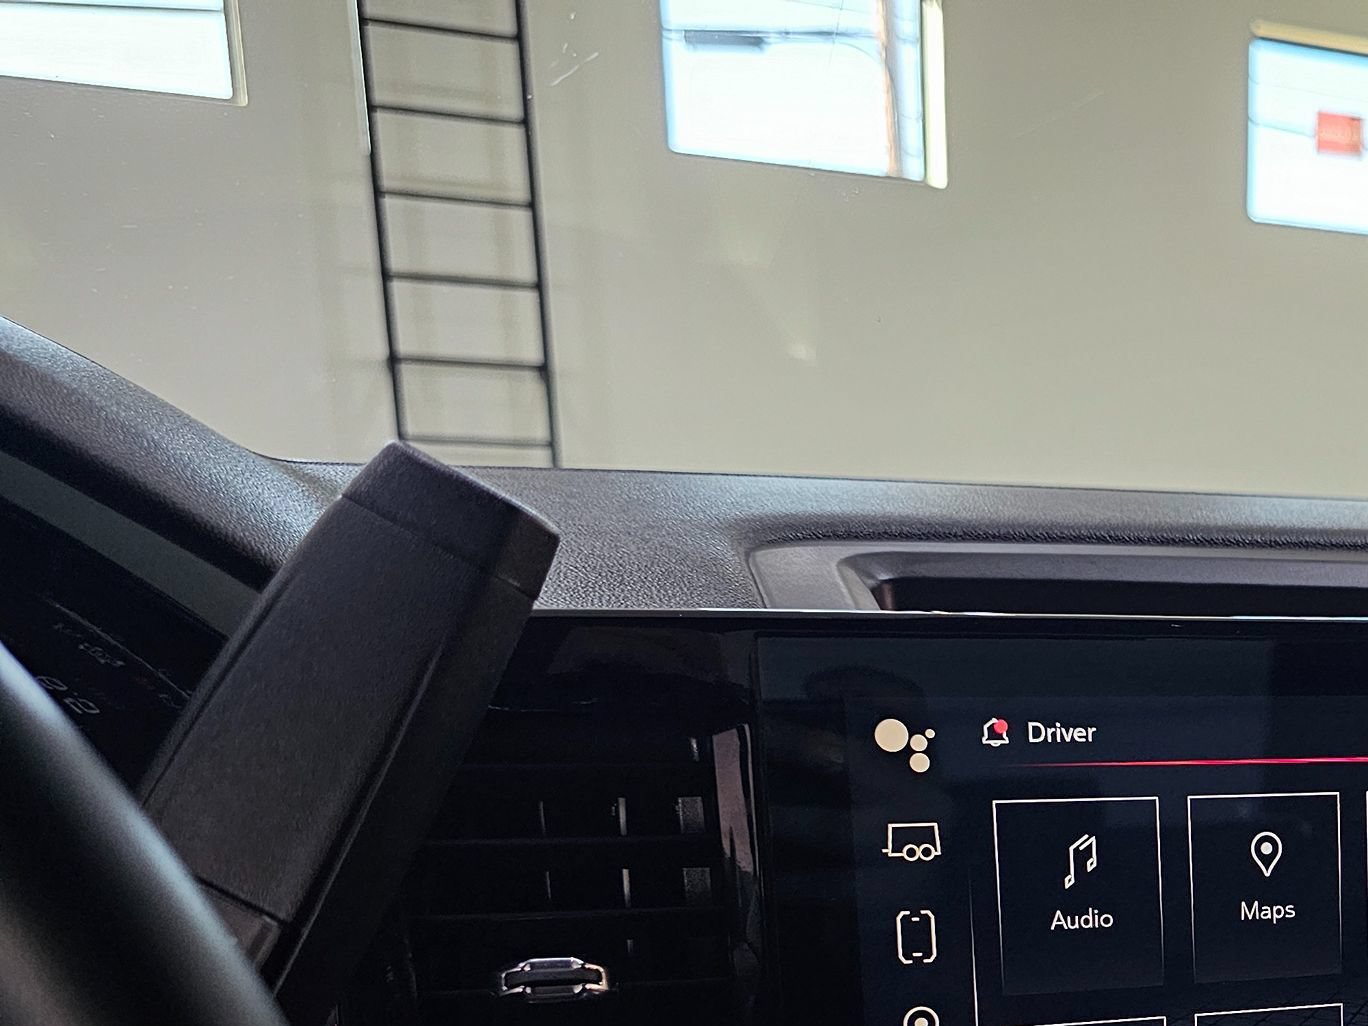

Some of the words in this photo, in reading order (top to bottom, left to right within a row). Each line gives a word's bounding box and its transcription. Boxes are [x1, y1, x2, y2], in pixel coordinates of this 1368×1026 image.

[1028, 722, 1096, 742] Driver
[1051, 908, 1113, 930] Audio
[1241, 901, 1295, 924] Maps
